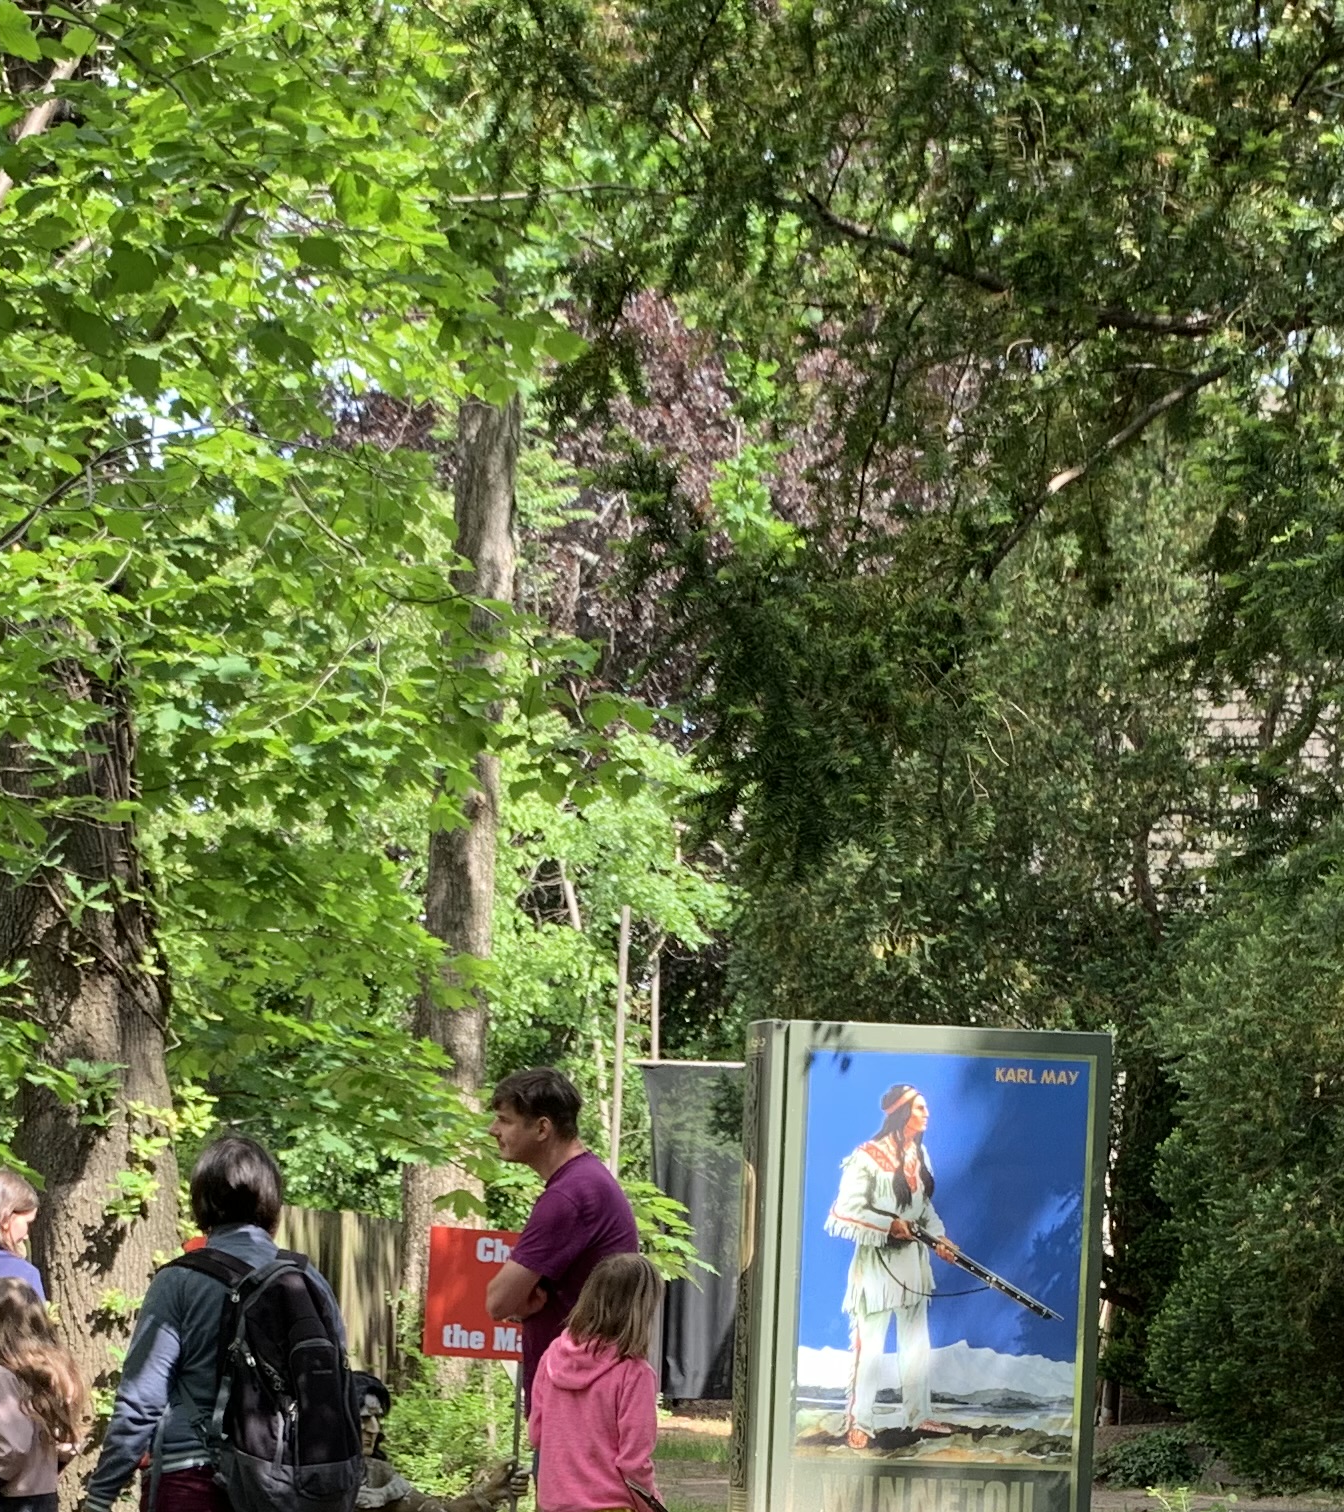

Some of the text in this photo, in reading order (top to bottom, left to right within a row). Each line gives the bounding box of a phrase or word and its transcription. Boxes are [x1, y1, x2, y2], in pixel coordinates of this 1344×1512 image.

[995, 1067, 1080, 1086] KARL MAY
[477, 1237, 515, 1263] Ch
[442, 1323, 485, 1350] the
